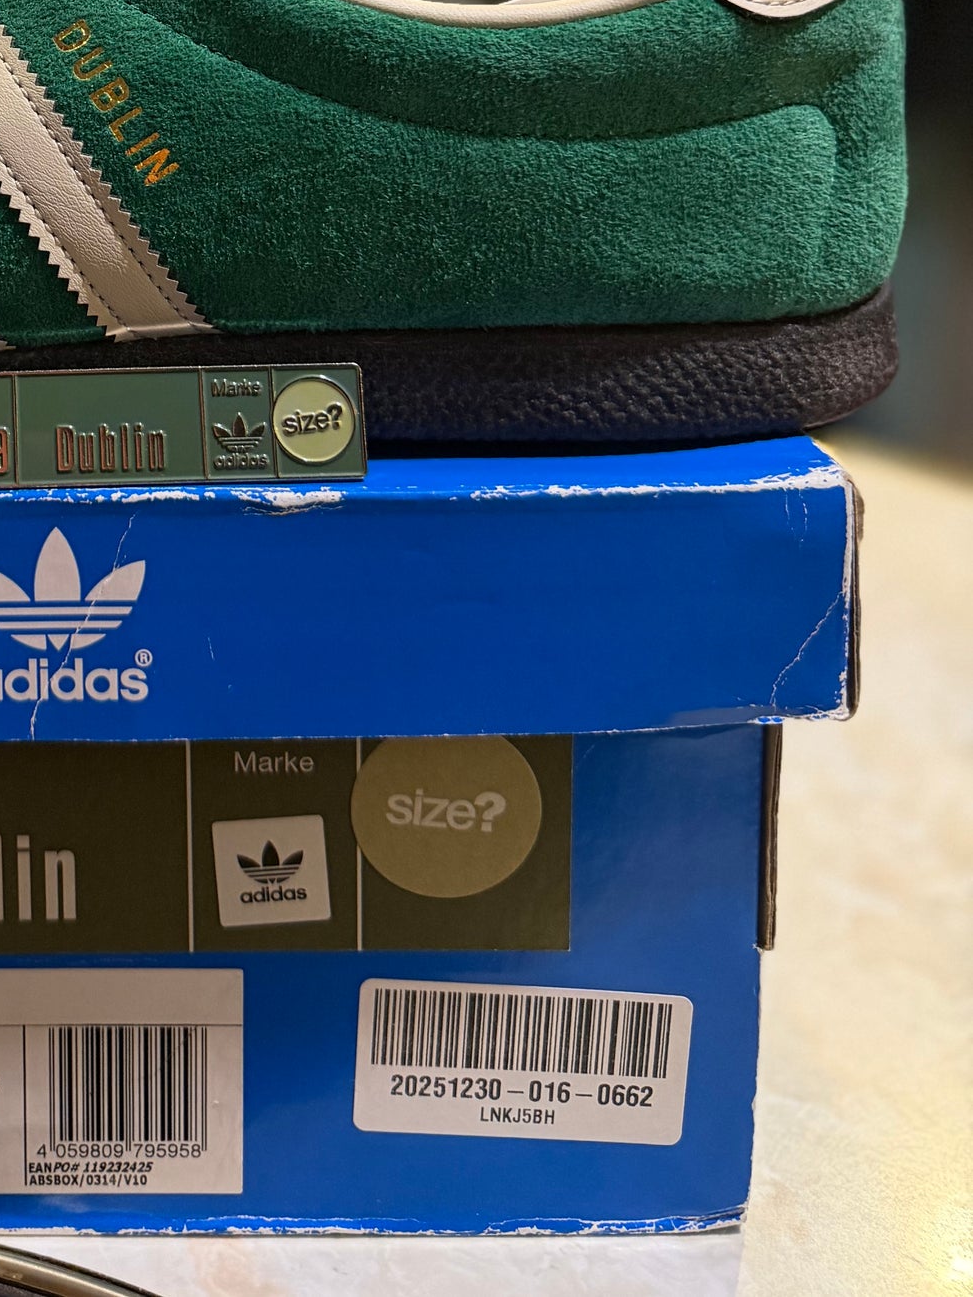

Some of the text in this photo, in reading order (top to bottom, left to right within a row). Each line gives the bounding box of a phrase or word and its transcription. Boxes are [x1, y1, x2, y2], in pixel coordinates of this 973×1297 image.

[53, 19, 179, 186] DUBLIN
[211, 379, 262, 397] Marke
[282, 402, 343, 436] size?
[55, 422, 166, 473] Dublin
[213, 453, 269, 470] adidas
[233, 751, 314, 773] Marke
[385, 788, 507, 833] size?
[240, 885, 307, 904] adidas
[480, 1106, 555, 1125] LNKJ5BH
[37, 1143, 201, 1158] 4 059809 795958
[83, 1161, 154, 1173] 119232425
